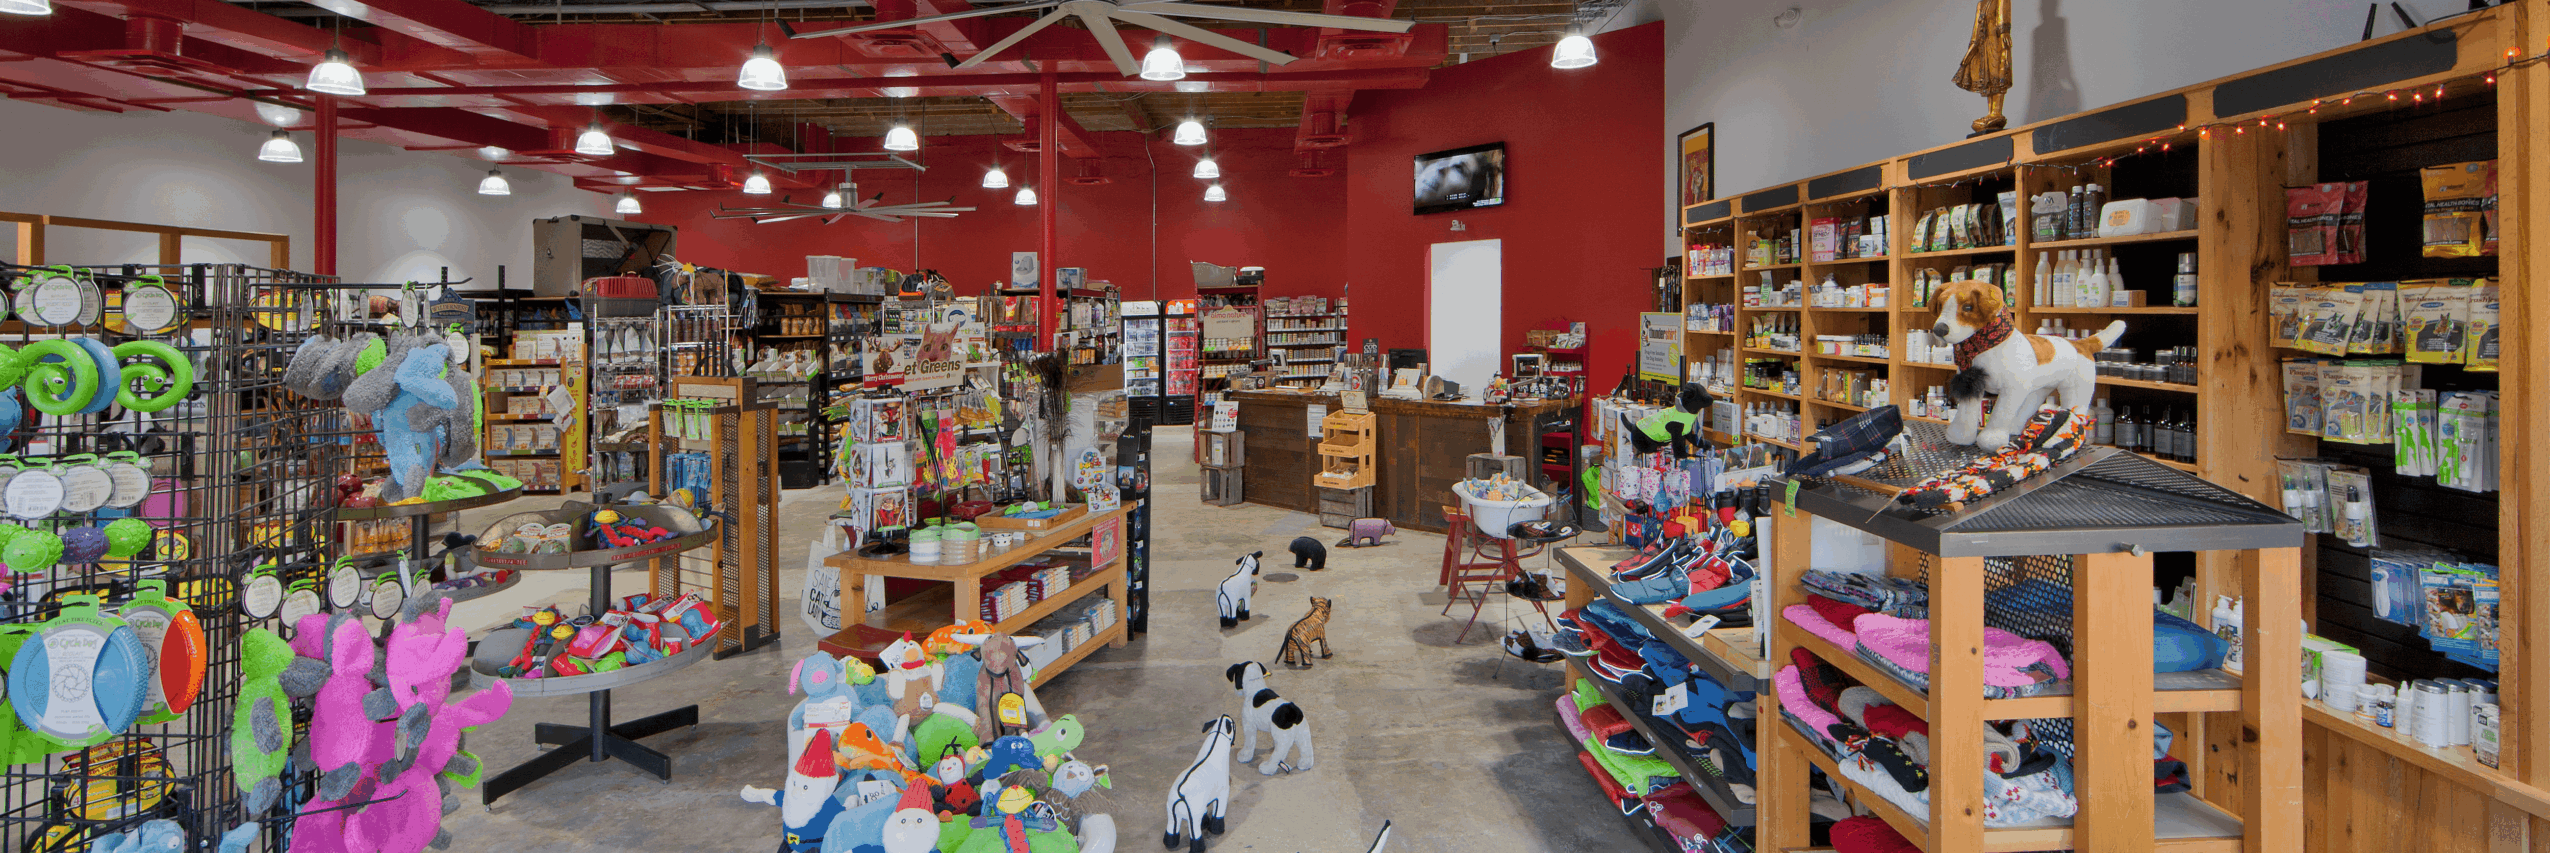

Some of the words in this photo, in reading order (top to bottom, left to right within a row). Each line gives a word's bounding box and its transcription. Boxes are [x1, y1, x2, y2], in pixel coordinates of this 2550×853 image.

[904, 362, 917, 376] et
[920, 360, 960, 374] Greens
[59, 637, 81, 650] Cycle
[82, 637, 100, 650] Dog
